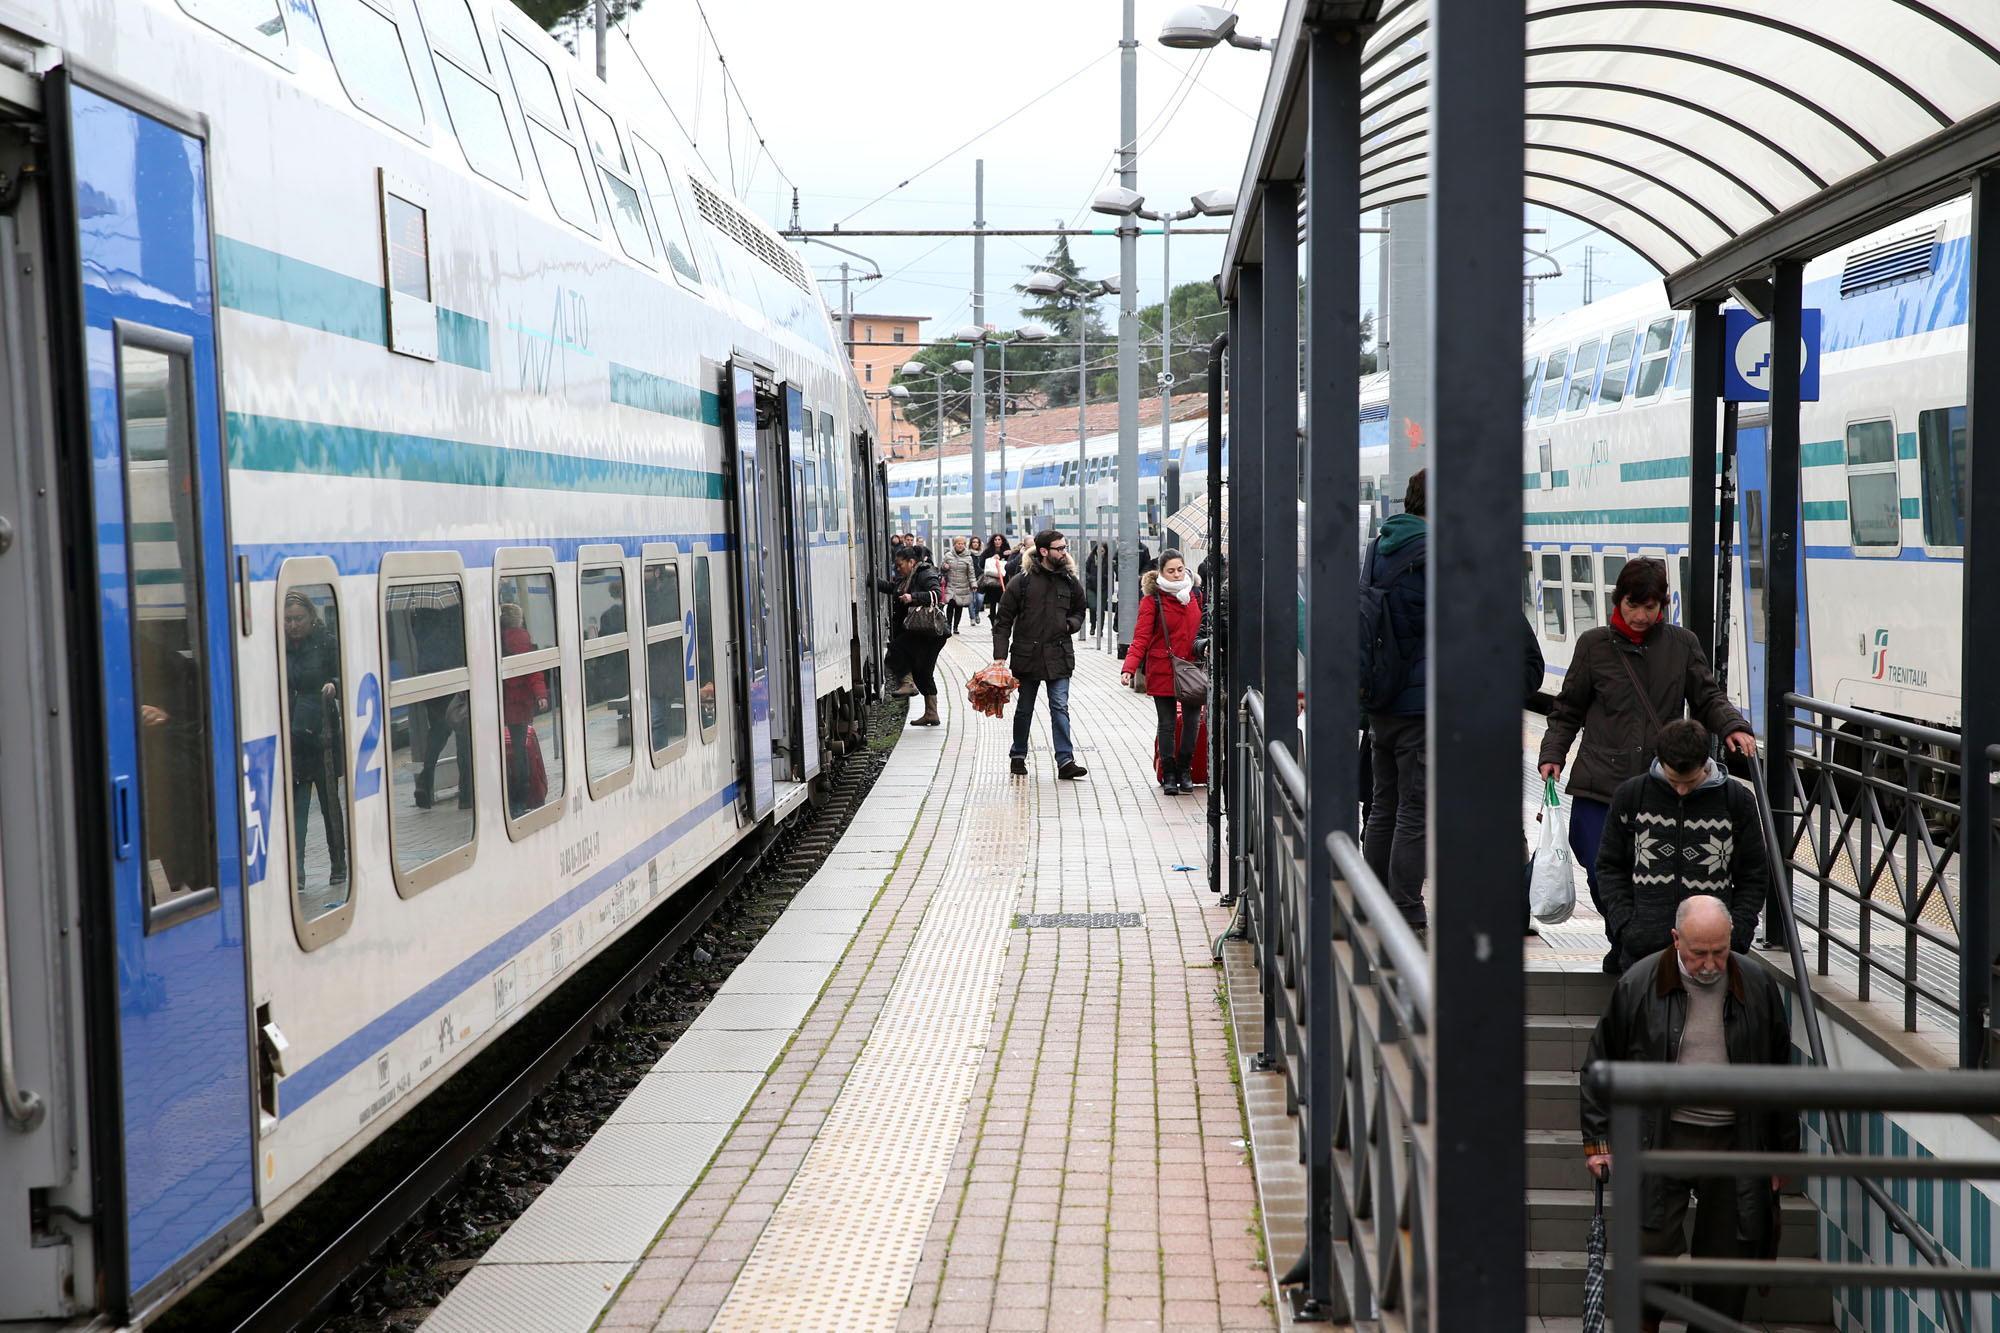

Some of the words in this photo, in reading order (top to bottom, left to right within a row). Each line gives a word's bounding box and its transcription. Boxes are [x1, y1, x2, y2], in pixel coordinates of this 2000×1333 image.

[1536, 579, 1543, 611] 2
[1672, 591, 1681, 627] 2
[684, 610, 696, 683] 2
[1888, 665, 1928, 688] TRENITALIA
[354, 672, 382, 802] 2
